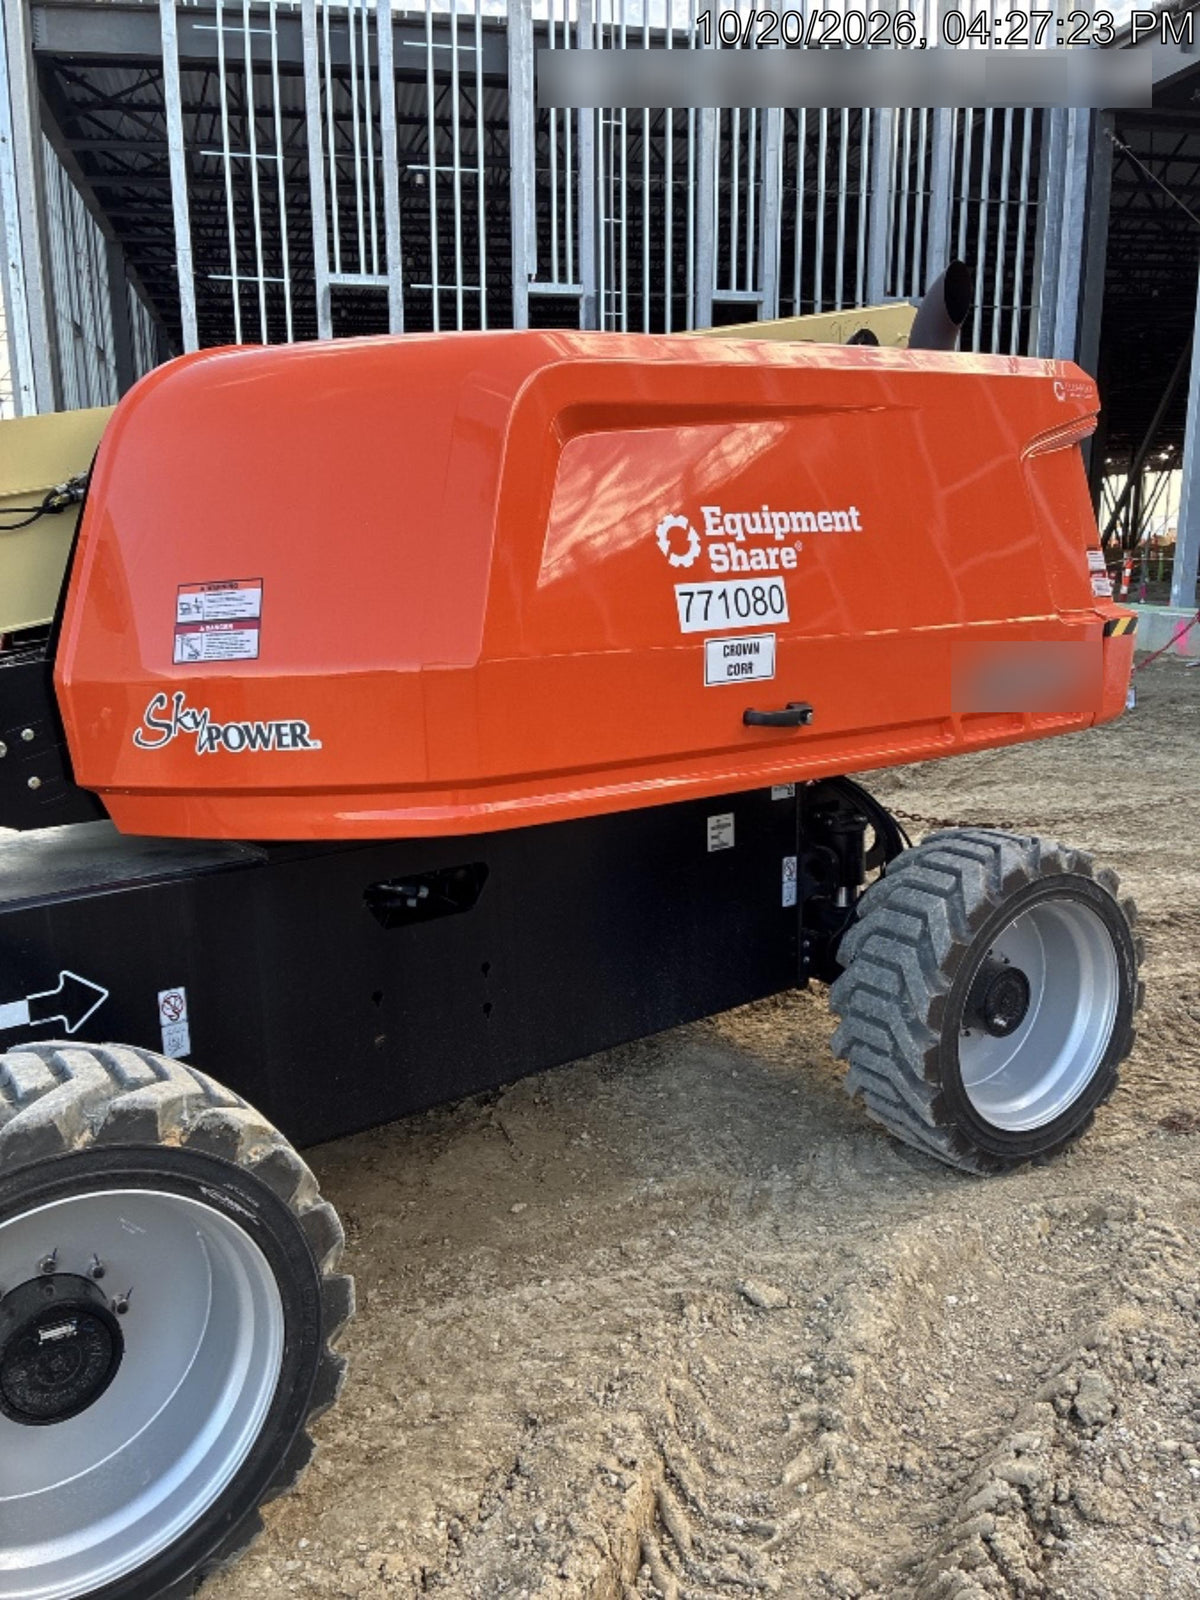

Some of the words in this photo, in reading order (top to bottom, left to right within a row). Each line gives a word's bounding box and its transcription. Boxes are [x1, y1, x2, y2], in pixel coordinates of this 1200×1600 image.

[701, 504, 862, 541] Equipment
[678, 584, 785, 623] 771080
[723, 641, 760, 658] CROWN
[727, 661, 754, 677] CORR
